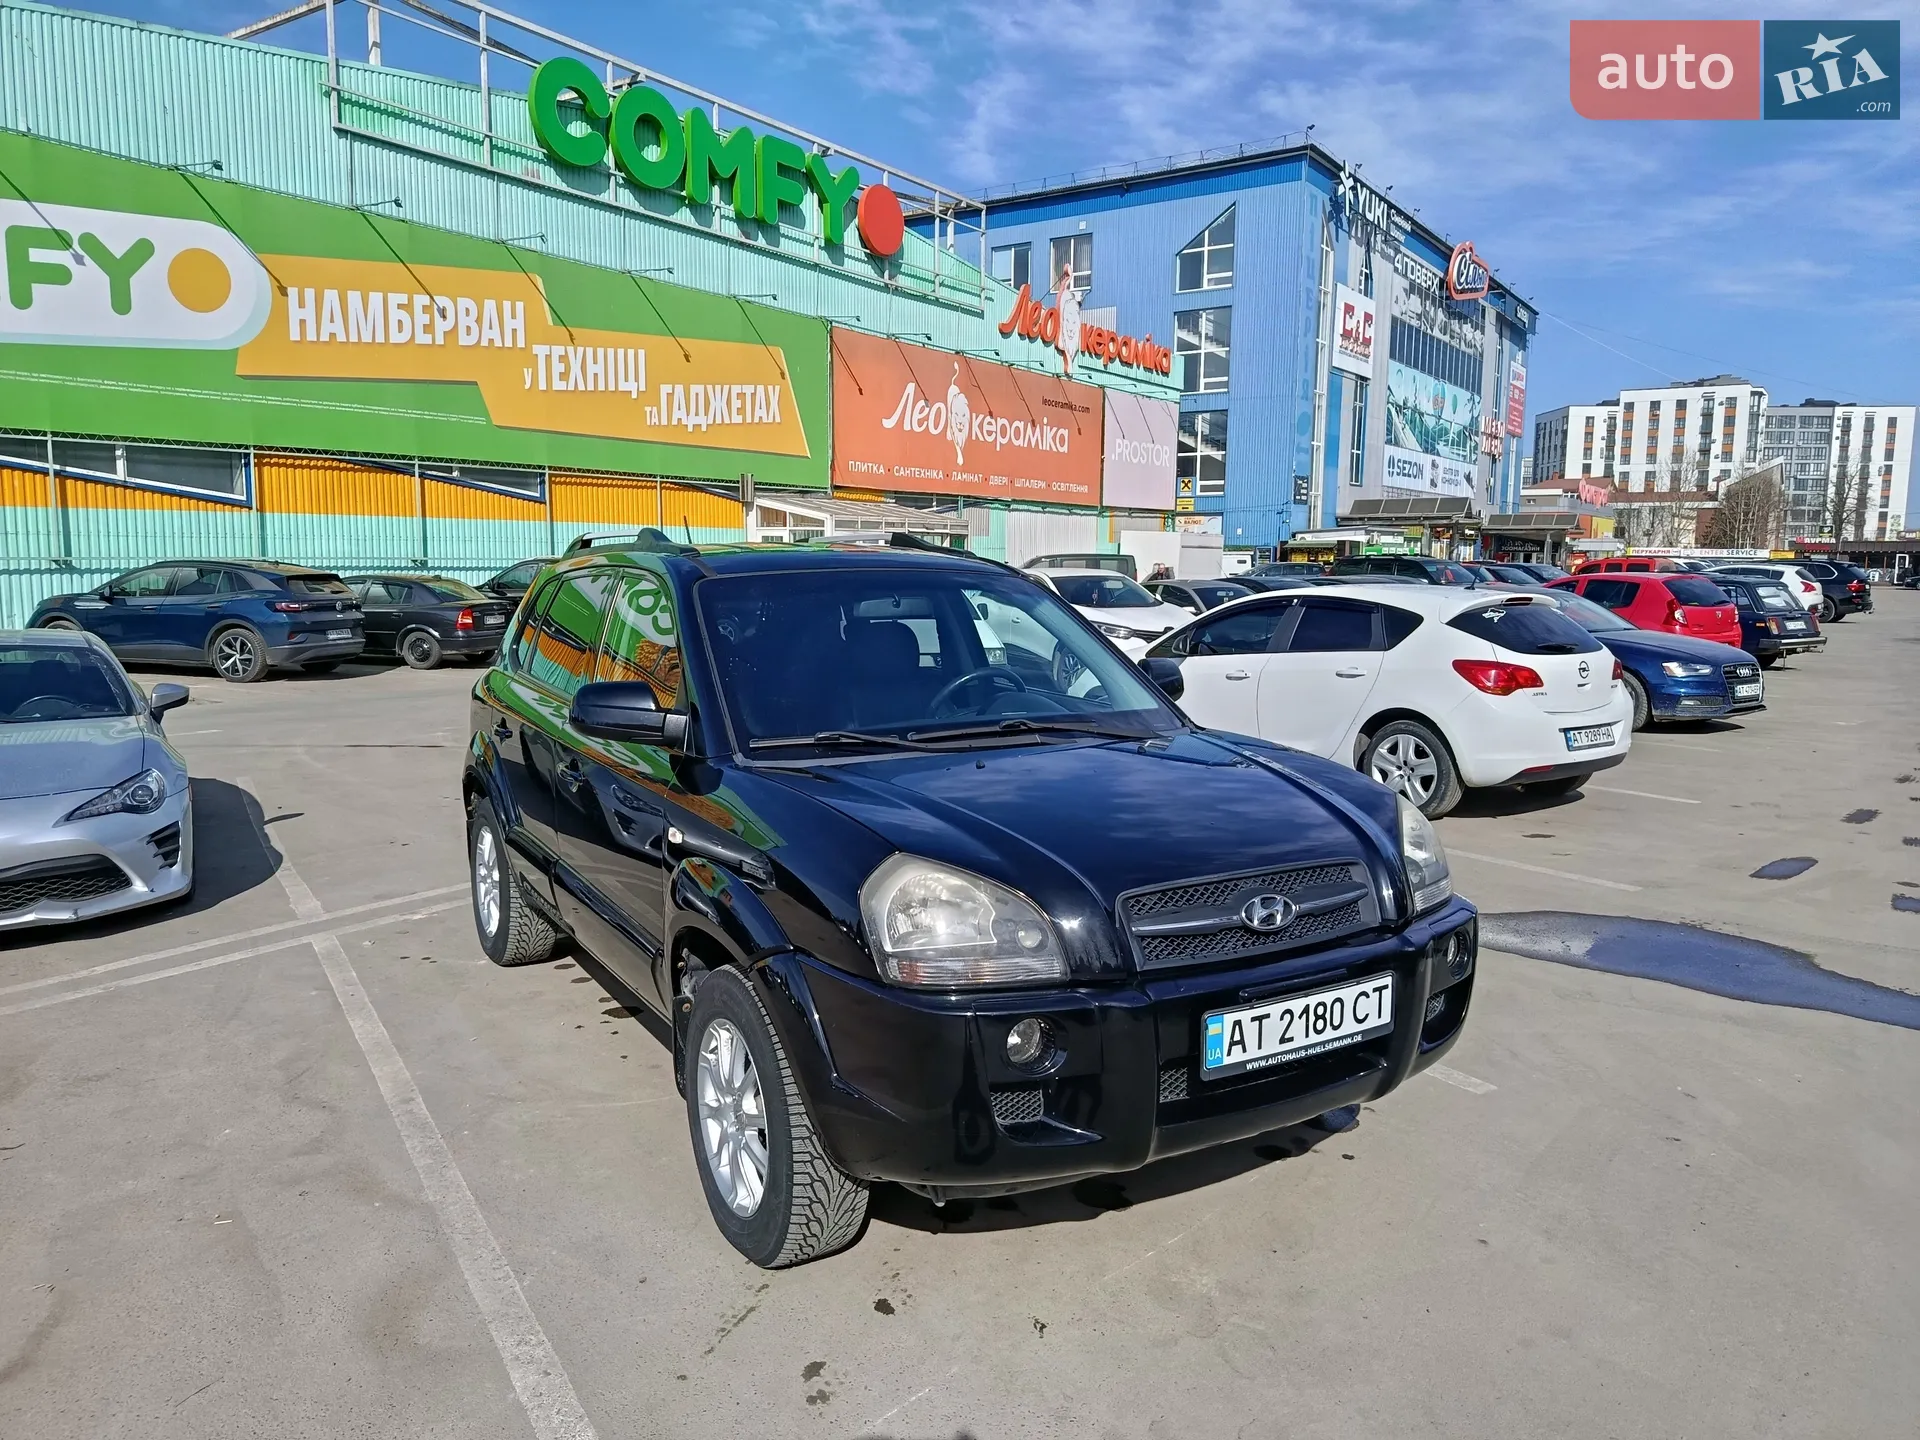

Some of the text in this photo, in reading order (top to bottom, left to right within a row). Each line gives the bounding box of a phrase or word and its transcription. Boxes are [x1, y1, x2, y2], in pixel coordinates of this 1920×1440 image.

[528, 57, 859, 245] COMFY
[1357, 183, 1388, 231] YUKI
[0, 224, 156, 316] FY
[1402, 257, 1440, 294] ПОВЕРХ
[287, 287, 526, 348] НАМБЕРВАН
[999, 284, 1171, 374] Лео кераміка
[533, 345, 647, 399] ТЕХНІЦІ
[659, 384, 781, 432] ГАДЖЕТАХ
[882, 383, 1069, 453] Лео кераміка
[1041, 396, 1091, 414] leoceramika.com
[848, 460, 1088, 493] ПЛИТКА САНТЕХНІКА ЛАМІНАТ ДВЕРІ ШПАЛЕРИ ОСВІТЛЕННЯ
[1396, 458, 1424, 481] SEZON
[1572, 727, 1613, 745] AT 9289 HA
[1226, 984, 1389, 1057] AT 2180 CT
[1208, 1049, 1222, 1061] UA
[1246, 1033, 1363, 1071] WWW.AUTOHAUS-HUELSEMANN.DE
